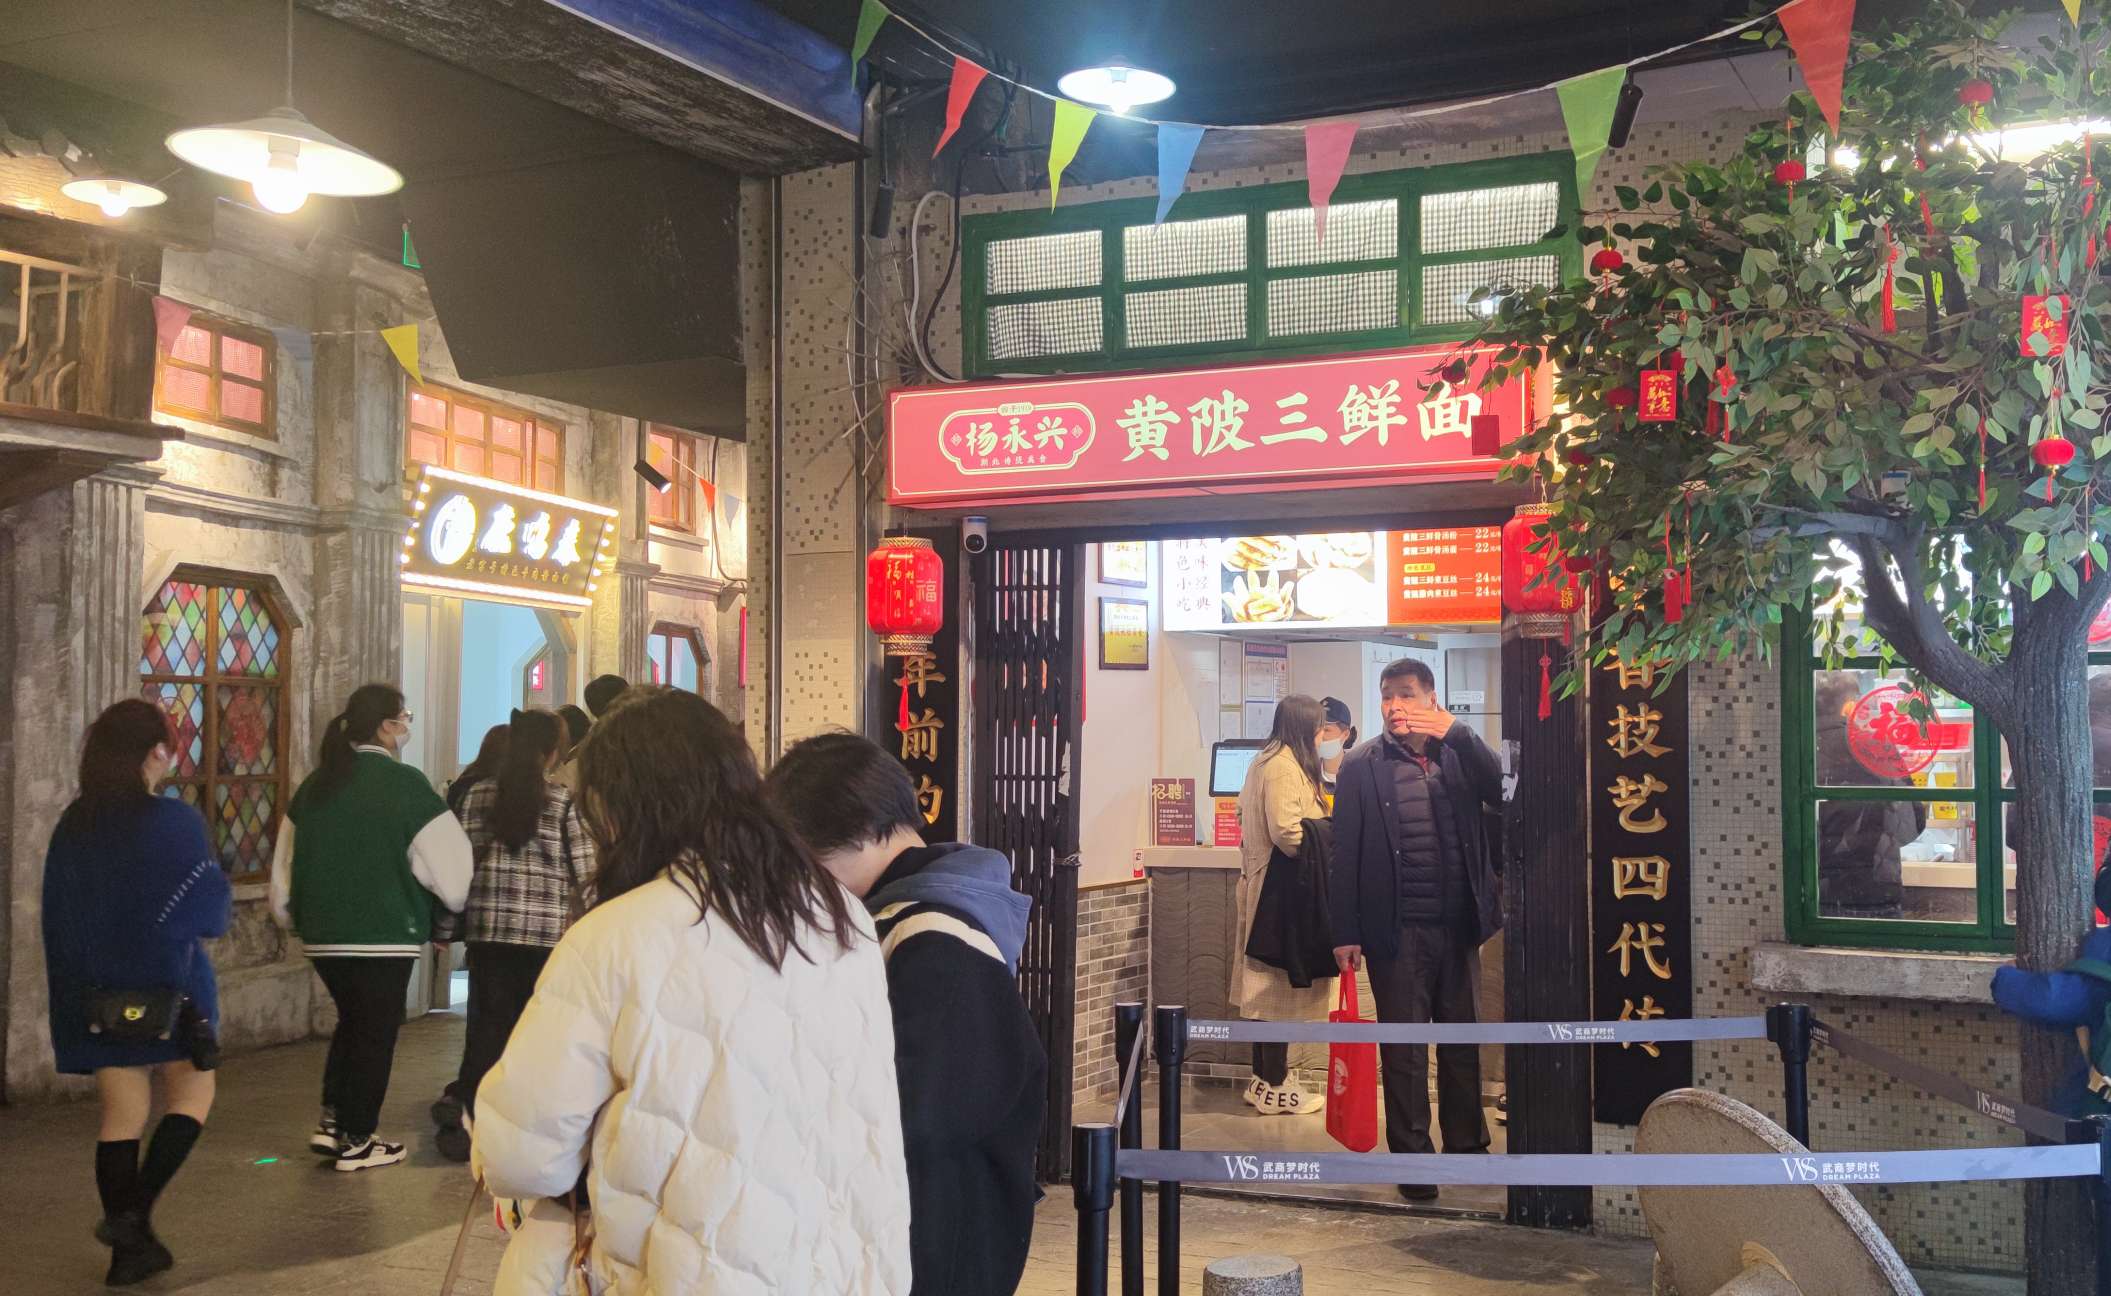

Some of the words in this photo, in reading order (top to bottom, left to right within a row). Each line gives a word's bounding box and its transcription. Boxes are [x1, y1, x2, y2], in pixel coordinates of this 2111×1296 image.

[1116, 379, 1483, 461] 黄陂三鲜面
[965, 416, 1068, 456] 杨永兴
[1222, 1155, 1259, 1180] WS
[1263, 1161, 1320, 1173] 武商梦时代
[1781, 1157, 1818, 1182] WS
[1822, 1161, 1880, 1174] 武商梦时代
